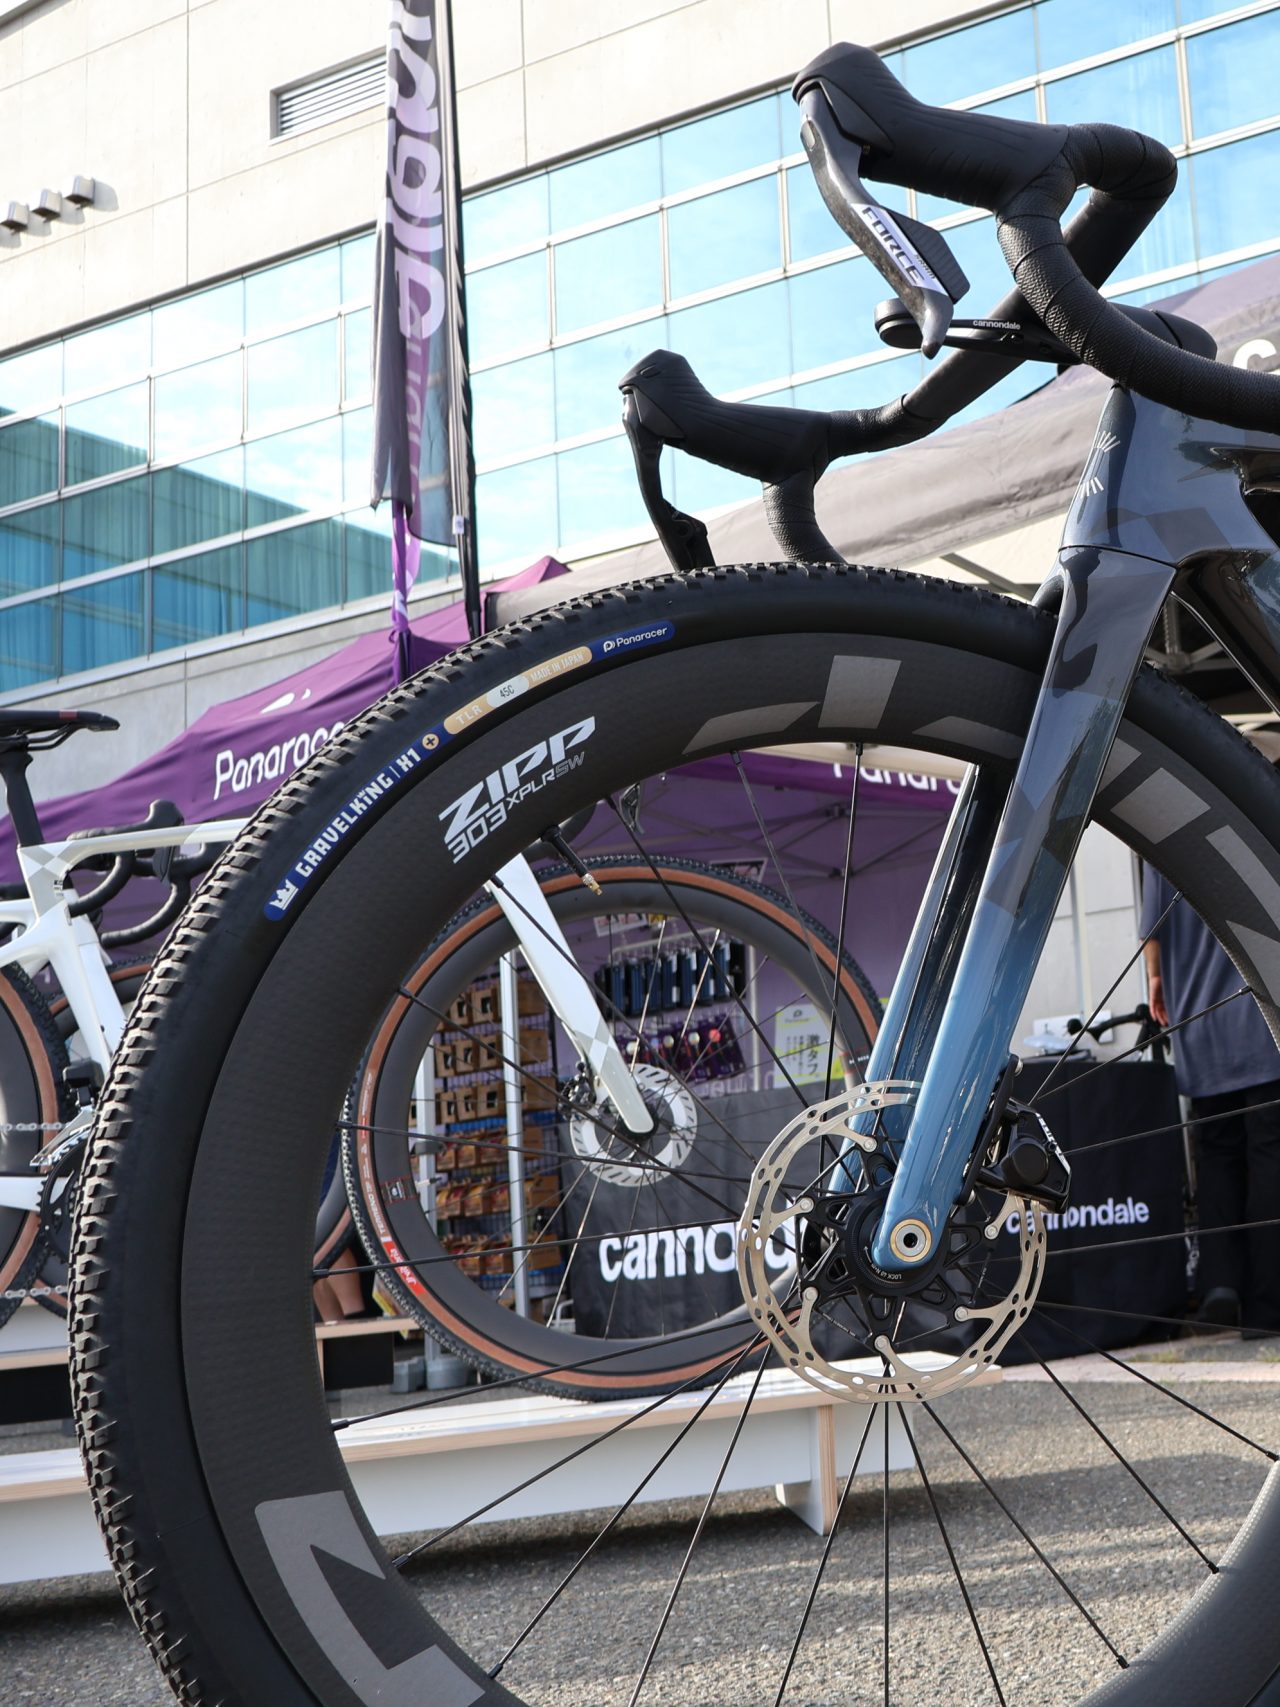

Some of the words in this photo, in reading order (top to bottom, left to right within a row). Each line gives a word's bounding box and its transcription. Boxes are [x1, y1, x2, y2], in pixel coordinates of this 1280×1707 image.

[862, 206, 925, 285] FORCE
[972, 319, 1021, 330] cannondale
[617, 627, 667, 648] Panaracer
[530, 667, 551, 683] MADE
[551, 662, 561, 674] IN
[560, 652, 584, 672] JAPAN
[500, 685, 514, 699] 45C
[456, 705, 482, 725] TLR
[438, 716, 596, 845] ZIPP
[295, 772, 394, 878] GRAVELKING
